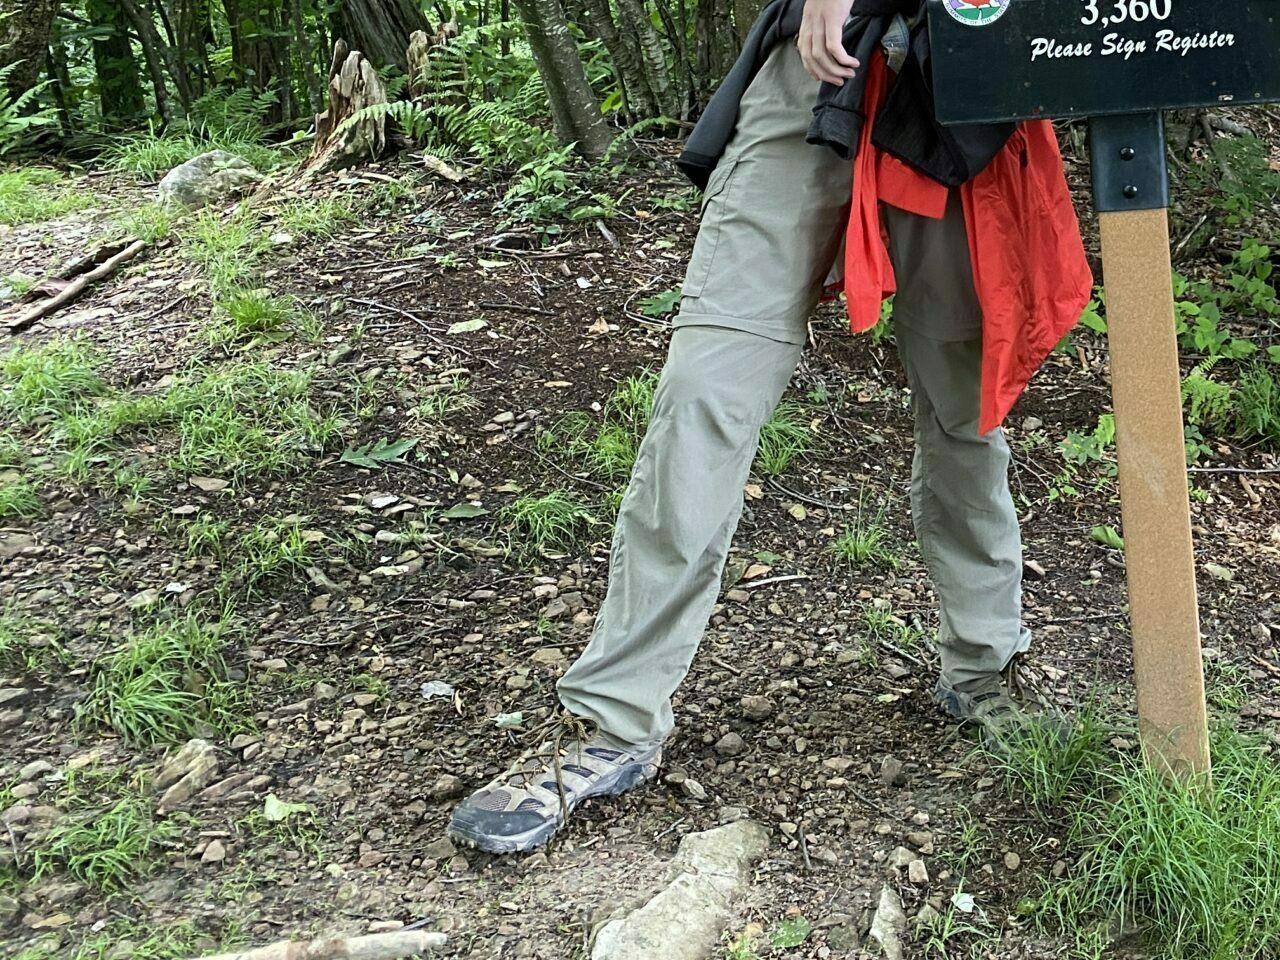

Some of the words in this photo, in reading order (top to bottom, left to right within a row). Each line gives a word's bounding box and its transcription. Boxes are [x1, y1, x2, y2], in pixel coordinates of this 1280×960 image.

[1030, 38, 1093, 61] Please
[1100, 33, 1147, 60] Sign
[1154, 29, 1235, 57] Register
